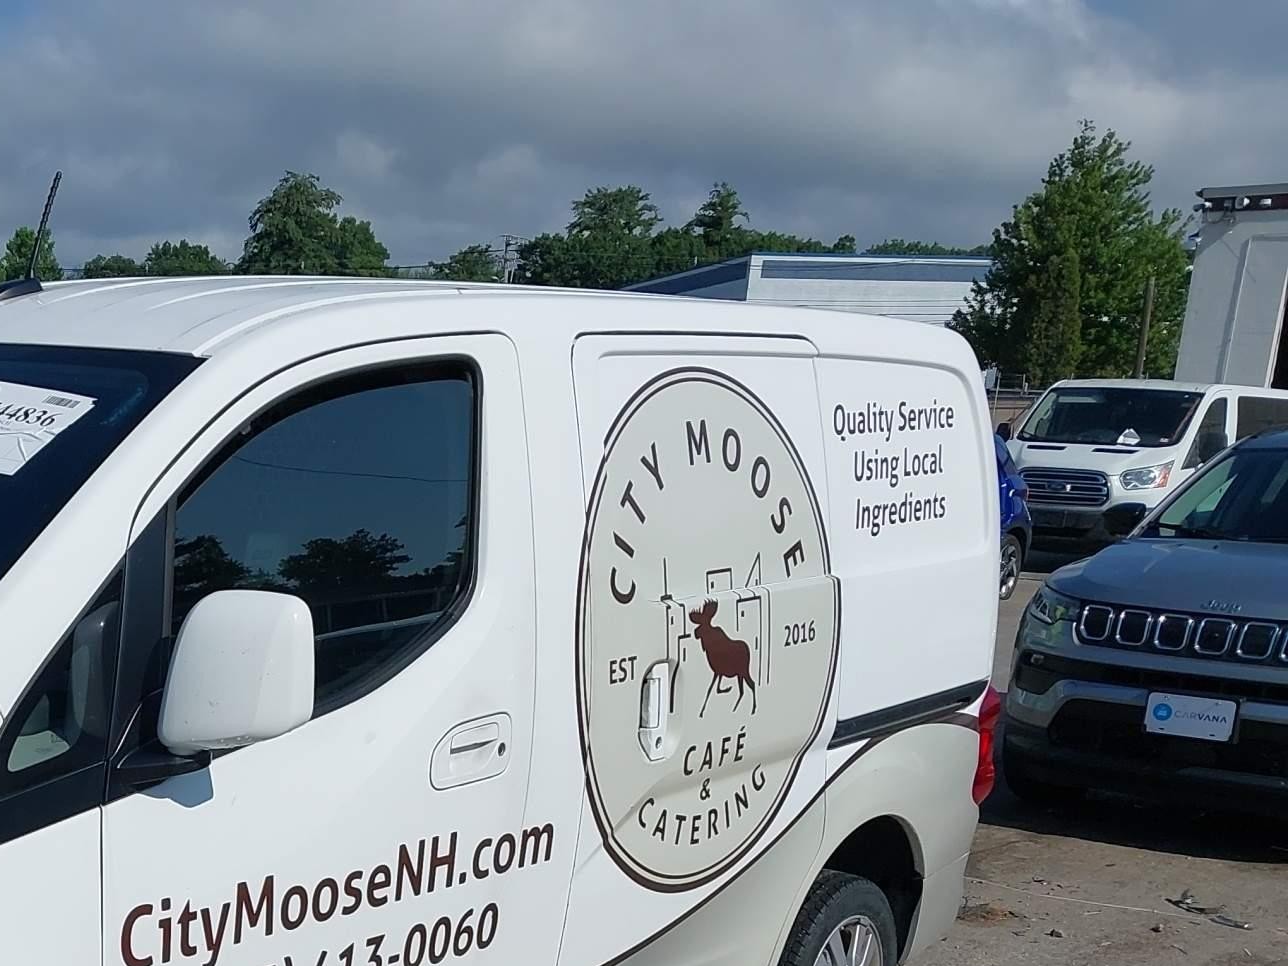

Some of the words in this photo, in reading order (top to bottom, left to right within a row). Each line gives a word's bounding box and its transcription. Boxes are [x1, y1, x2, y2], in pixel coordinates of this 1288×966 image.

[833, 402, 894, 442] Quality
[898, 399, 954, 431] Service
[854, 449, 900, 488] Using
[903, 444, 943, 477] Local
[610, 441, 664, 605] CITY
[685, 419, 805, 578] MOOSE
[856, 492, 946, 537] Ingredients
[609, 656, 637, 684] EST
[784, 620, 816, 647] 2016
[1174, 710, 1227, 724] CARVANA
[683, 725, 747, 776] CAFÉ
[638, 763, 766, 845] CATERING
[699, 778, 711, 801] &
